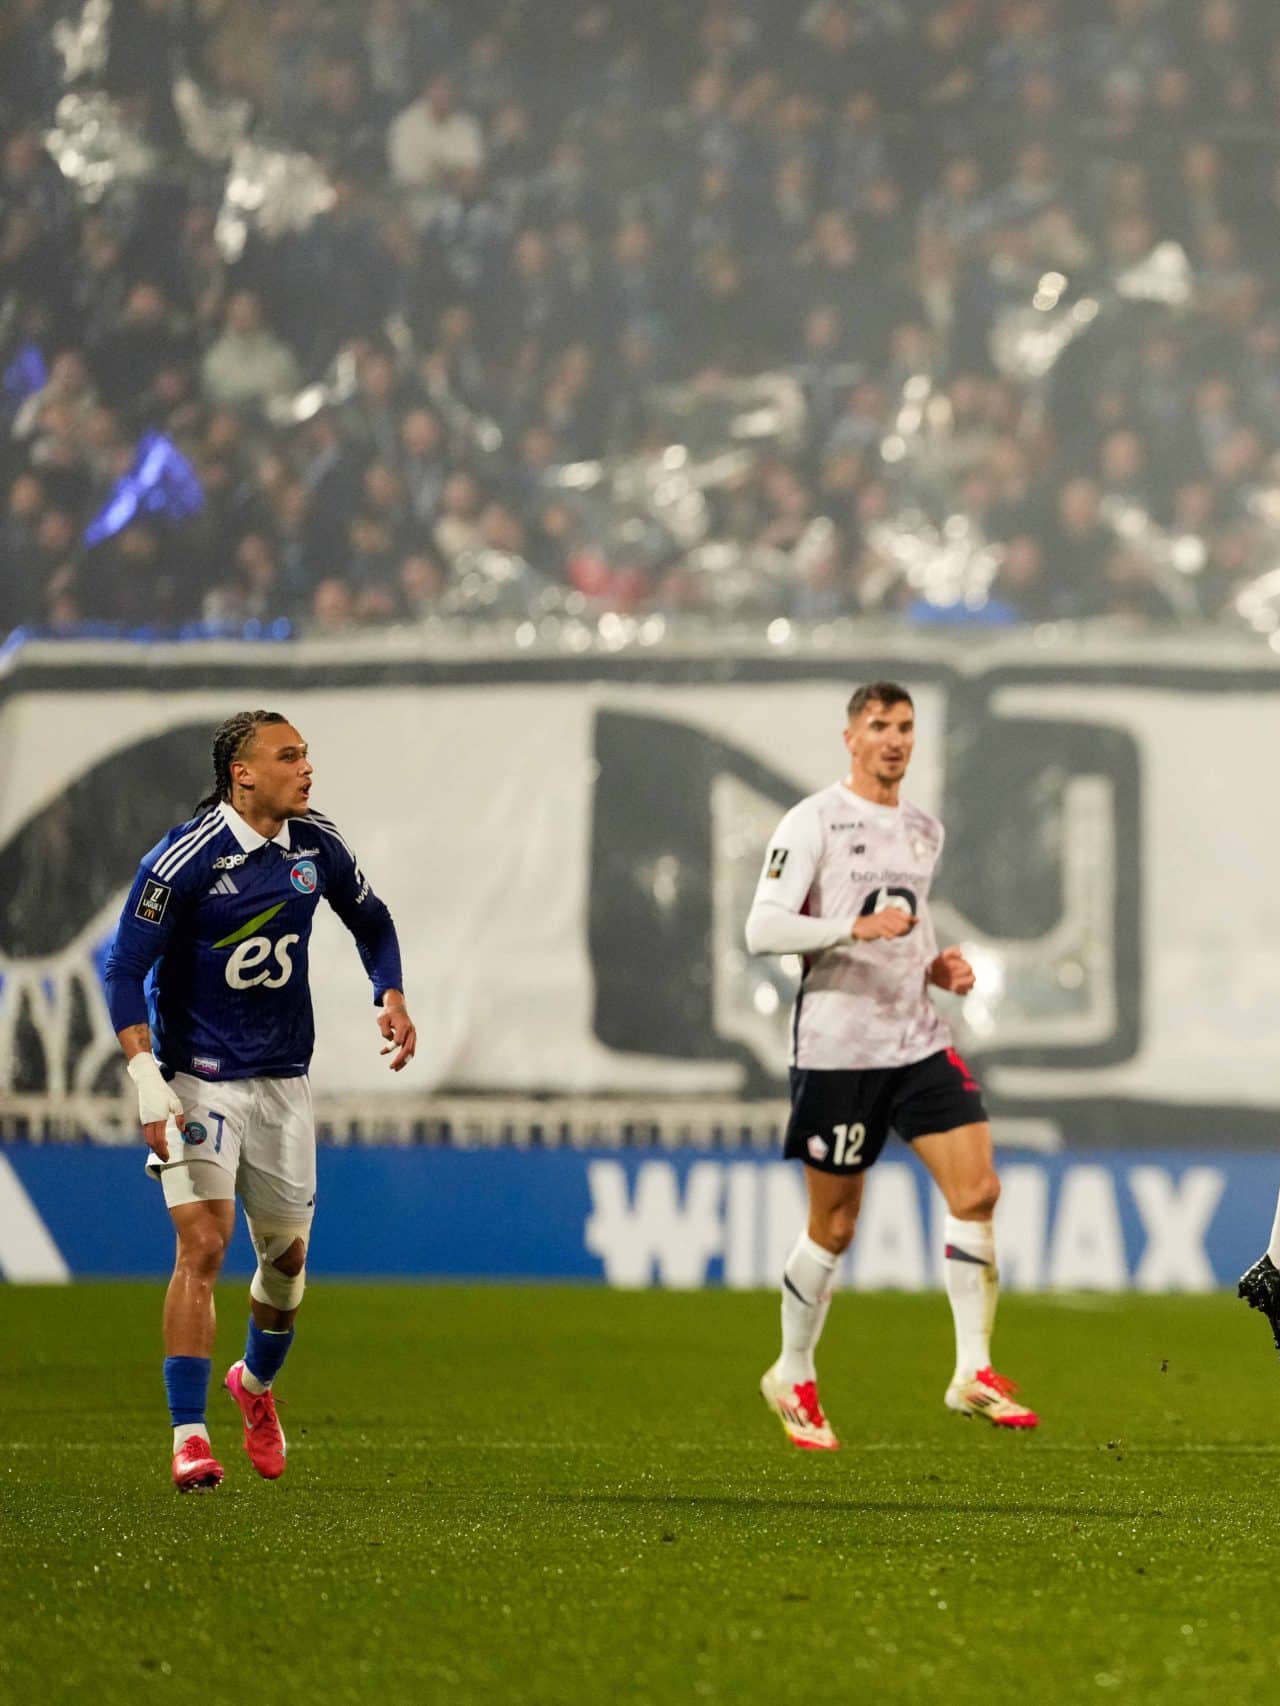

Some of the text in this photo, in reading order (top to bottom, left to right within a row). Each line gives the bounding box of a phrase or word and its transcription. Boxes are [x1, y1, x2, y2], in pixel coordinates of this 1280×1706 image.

[212, 853, 249, 870] ager
[225, 933, 300, 990] es
[208, 1111, 227, 1155] 7
[832, 1122, 866, 1167] 12
